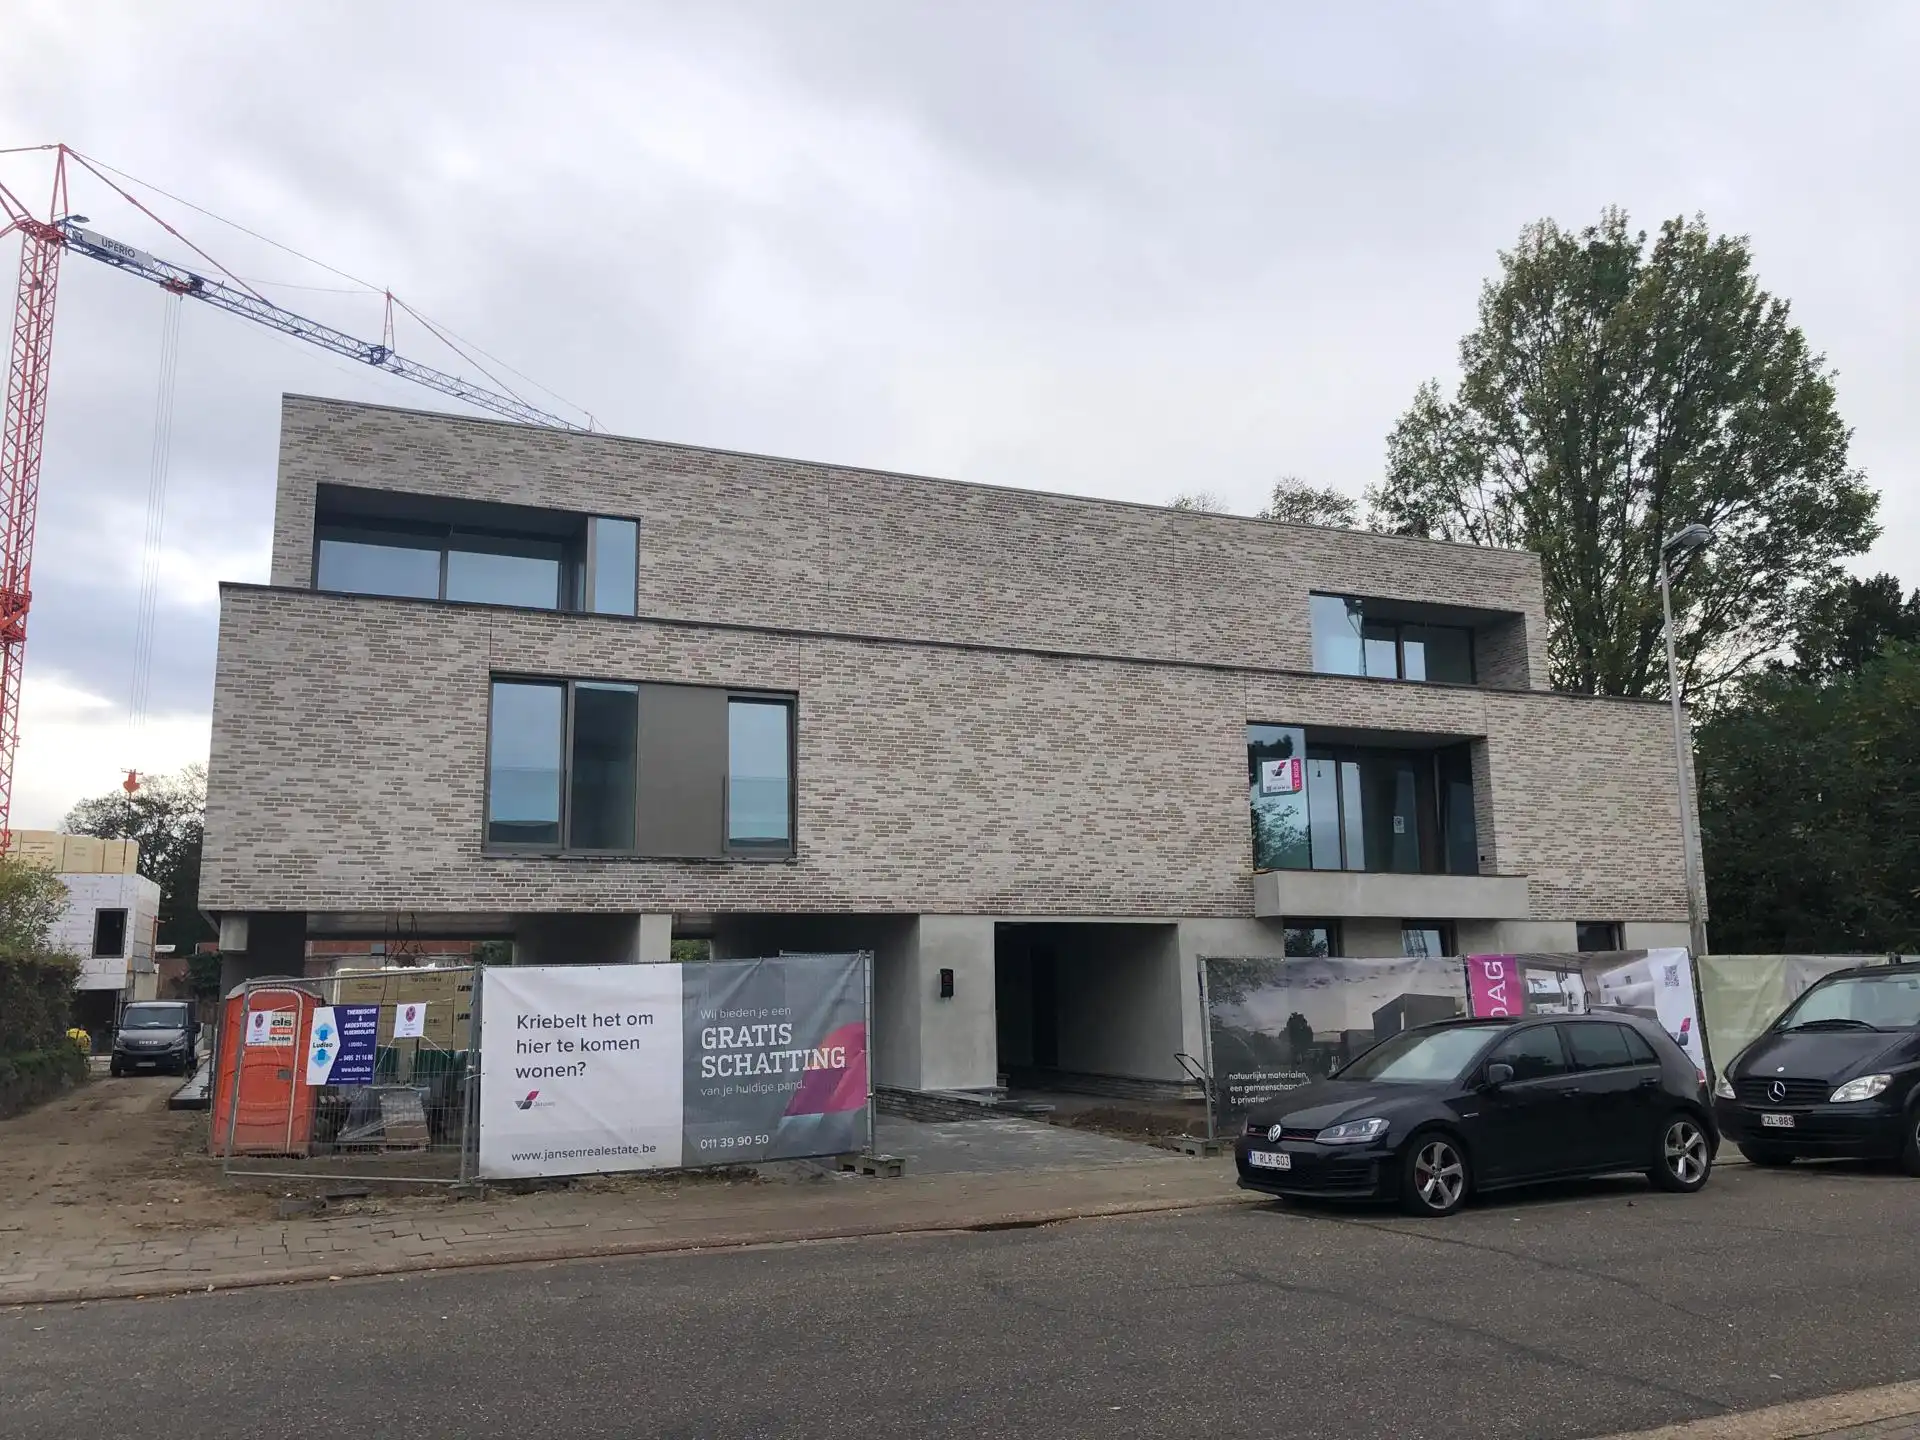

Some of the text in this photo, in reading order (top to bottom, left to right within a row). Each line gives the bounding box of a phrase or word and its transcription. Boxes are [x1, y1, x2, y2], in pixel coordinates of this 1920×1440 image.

[101, 238, 136, 258] UPERIO
[516, 1012, 654, 1030] Kriebelt het om
[700, 1006, 791, 1020] Wij bieden je een
[516, 1037, 640, 1054] hier te komen
[701, 1023, 792, 1050] GRATIS
[516, 1061, 587, 1079] wonen?
[701, 1046, 847, 1079] SCHATTING
[1228, 1071, 1267, 1081] natuurlijke
[700, 1079, 806, 1097] van je huldige pand.
[1230, 1095, 1237, 1104] &
[700, 1134, 769, 1149] 011 39 90 50
[511, 1144, 657, 1162] www.jansenrealestate.be
